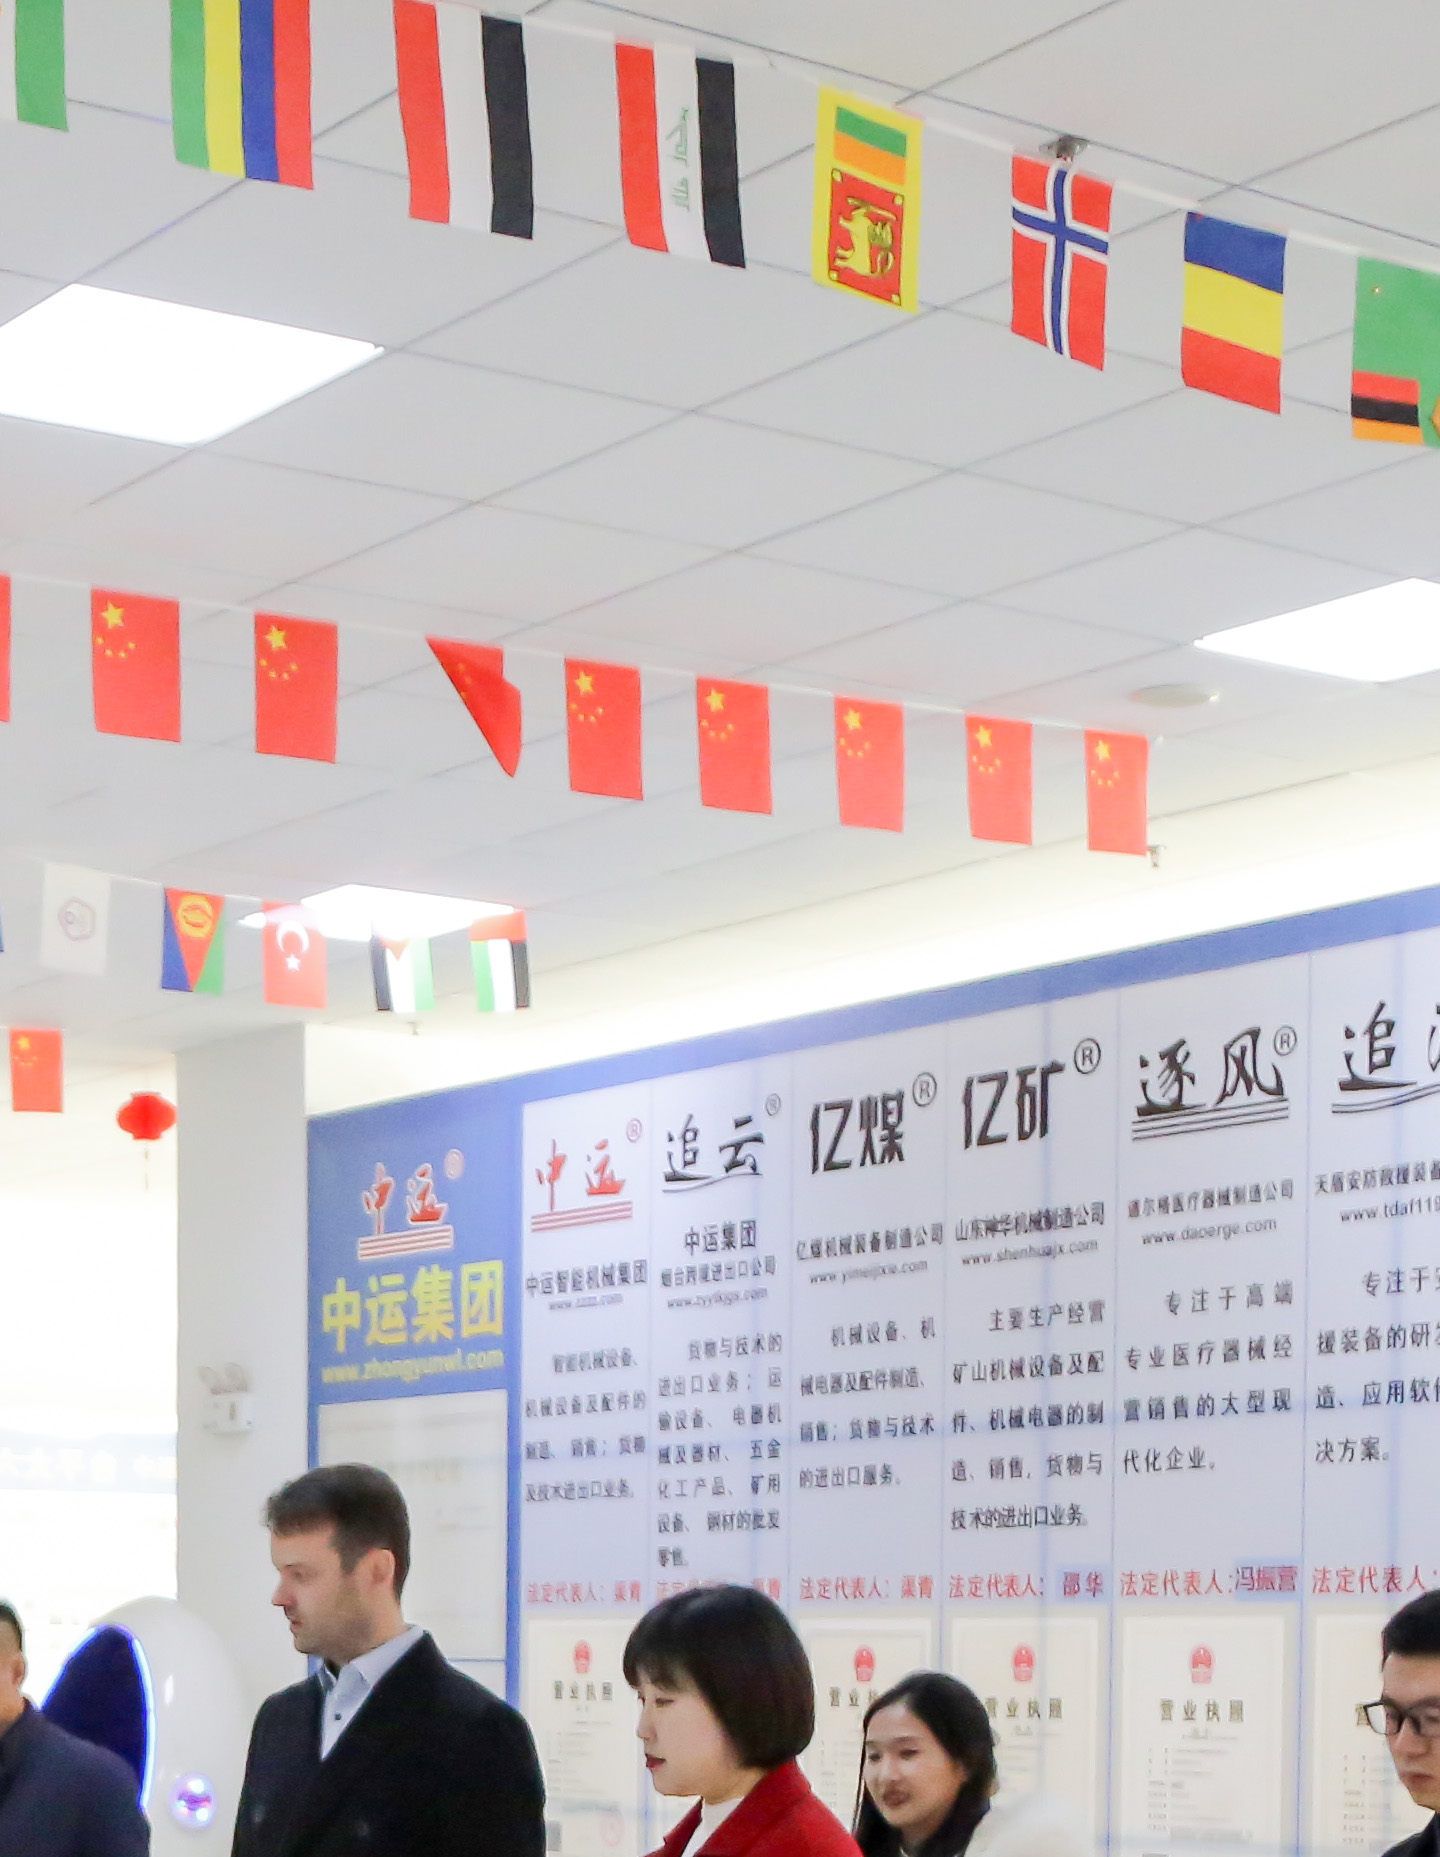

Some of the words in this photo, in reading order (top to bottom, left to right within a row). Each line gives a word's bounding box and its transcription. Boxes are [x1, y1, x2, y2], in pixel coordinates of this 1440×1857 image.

[1136, 1026, 1285, 1116] 逐风
[962, 1059, 1066, 1151] 亿矿
[662, 1113, 765, 1182] 追云
[809, 1088, 906, 1175] 亿煤
[685, 1217, 757, 1257] 中运集团
[322, 1259, 504, 1353] 中运集团
[988, 1300, 1106, 1332] 主要生产经营
[1165, 1280, 1294, 1316] 专注于高端
[953, 1350, 1105, 1385] 矿山机械设备及配
[1124, 1333, 1292, 1372] 专业医疗器械经
[952, 1400, 1105, 1435] 件、机械电器的制
[1123, 1387, 1291, 1424] 营销售的大型现
[1123, 1445, 1216, 1475] 代化企业。
[1315, 1434, 1390, 1464] 决方案。
[1160, 1698, 1244, 1723] 营业执照
